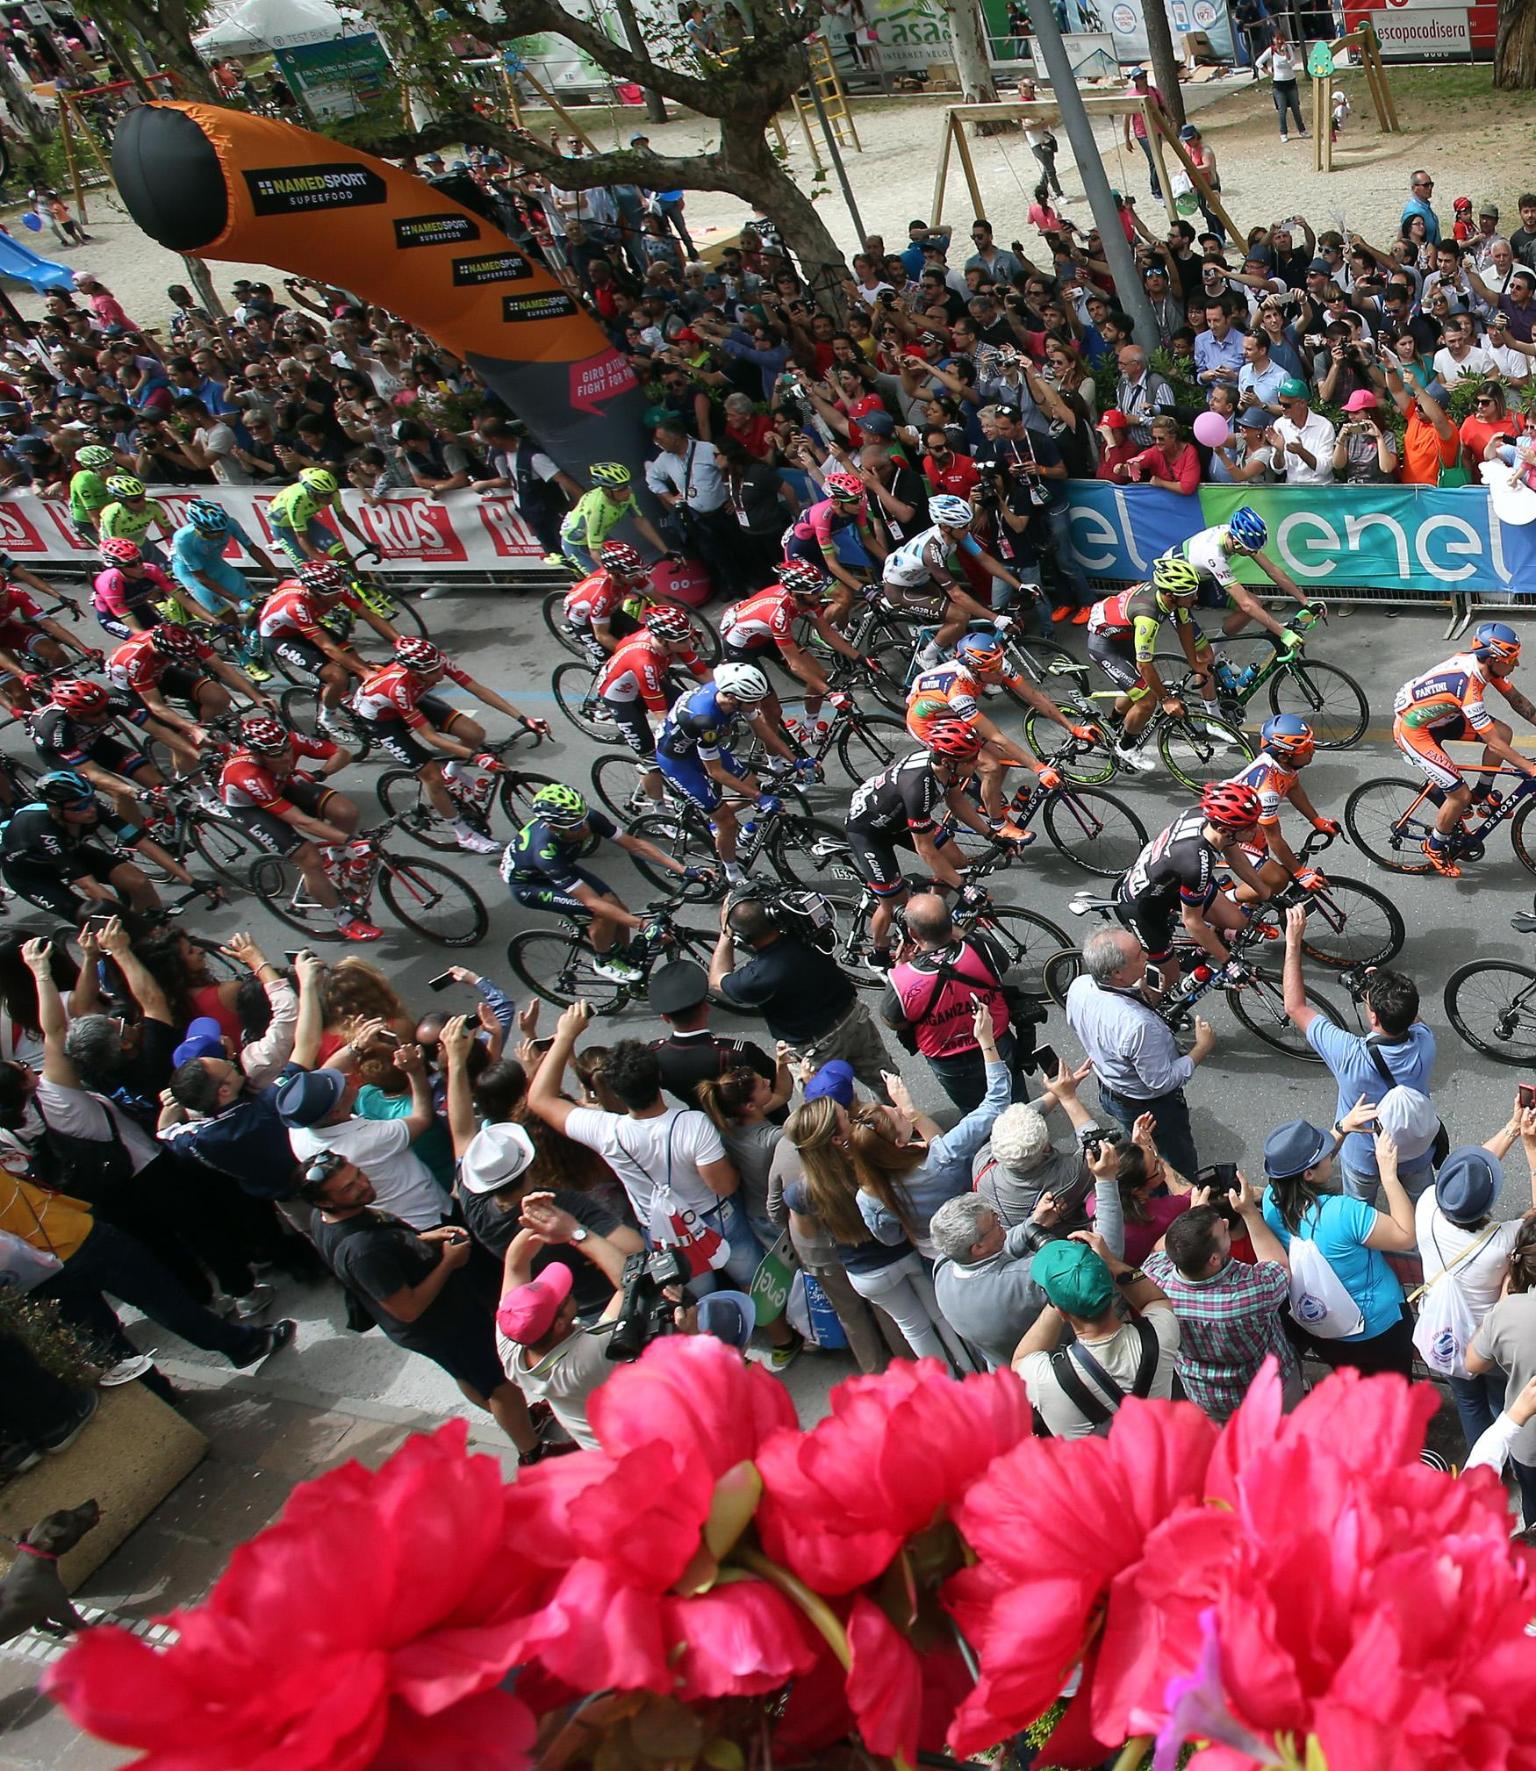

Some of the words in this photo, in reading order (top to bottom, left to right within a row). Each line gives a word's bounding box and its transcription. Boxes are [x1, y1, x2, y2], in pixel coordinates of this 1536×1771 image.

[1378, 18, 1466, 42] escopocodisera
[273, 173, 367, 194] NAMEDSPORT
[290, 191, 353, 206] SUPERFOOD
[410, 220, 469, 234] NAMEDSPORT
[419, 231, 461, 242] SUPERFOOD
[469, 258, 523, 272] NAMEDSPORT
[477, 269, 517, 280] SUPERFOOD
[519, 296, 568, 310] NAMEDSPORT
[582, 366, 604, 382] GIRO
[577, 379, 605, 397] FIGHT
[372, 501, 446, 550] RDS
[1064, 488, 1147, 571] el
[1277, 493, 1514, 584] enel
[276, 642, 306, 666] lotto
[580, 632, 605, 657] lotto
[1415, 681, 1448, 699] FANTINI
[617, 721, 641, 751] lotto
[381, 735, 411, 764] lotto
[1421, 765, 1449, 789] NIPPO
[1484, 810, 1499, 829] DE
[1496, 793, 1519, 818] ROSA
[868, 859, 886, 883] GIANT
[1198, 849, 1209, 892] Sunweb
